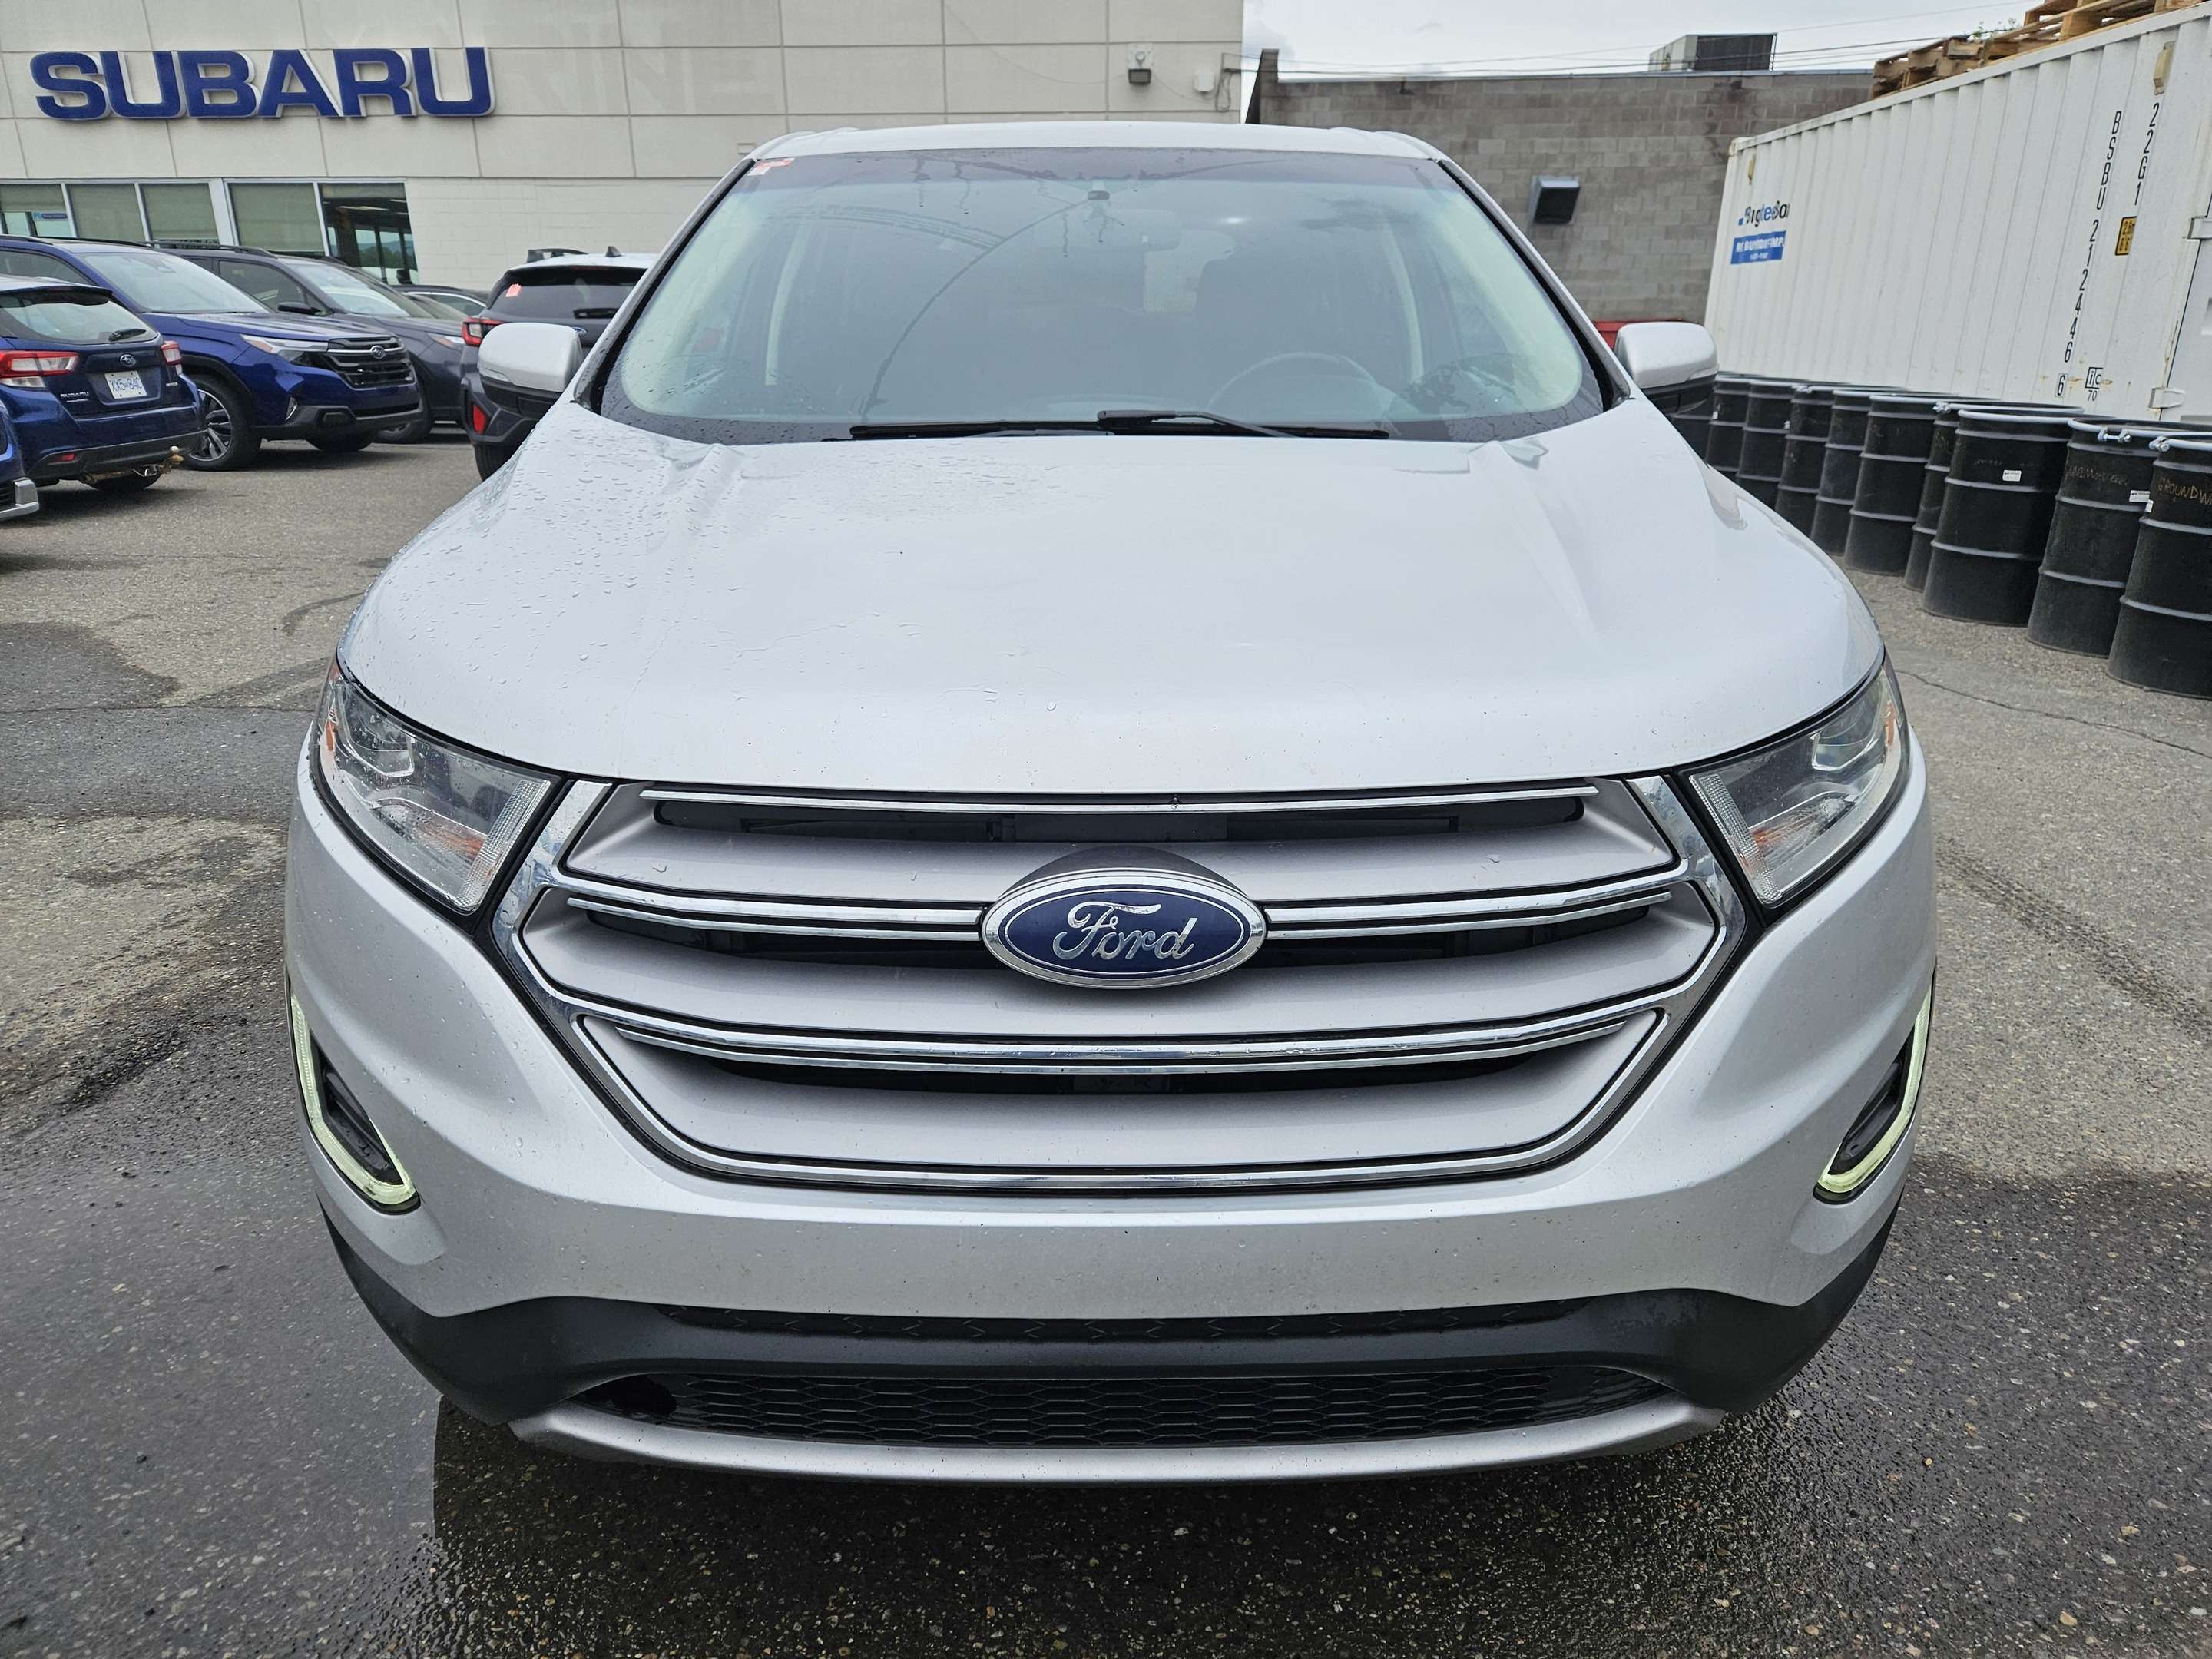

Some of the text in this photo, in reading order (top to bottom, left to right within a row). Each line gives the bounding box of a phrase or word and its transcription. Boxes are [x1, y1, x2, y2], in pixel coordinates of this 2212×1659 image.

[30, 47, 495, 120] SUBARU
[2096, 111, 2122, 210] BSBU
[2134, 102, 2159, 206] 22G1
[2064, 219, 2099, 363] 212446
[1052, 901, 1198, 961] Ford
